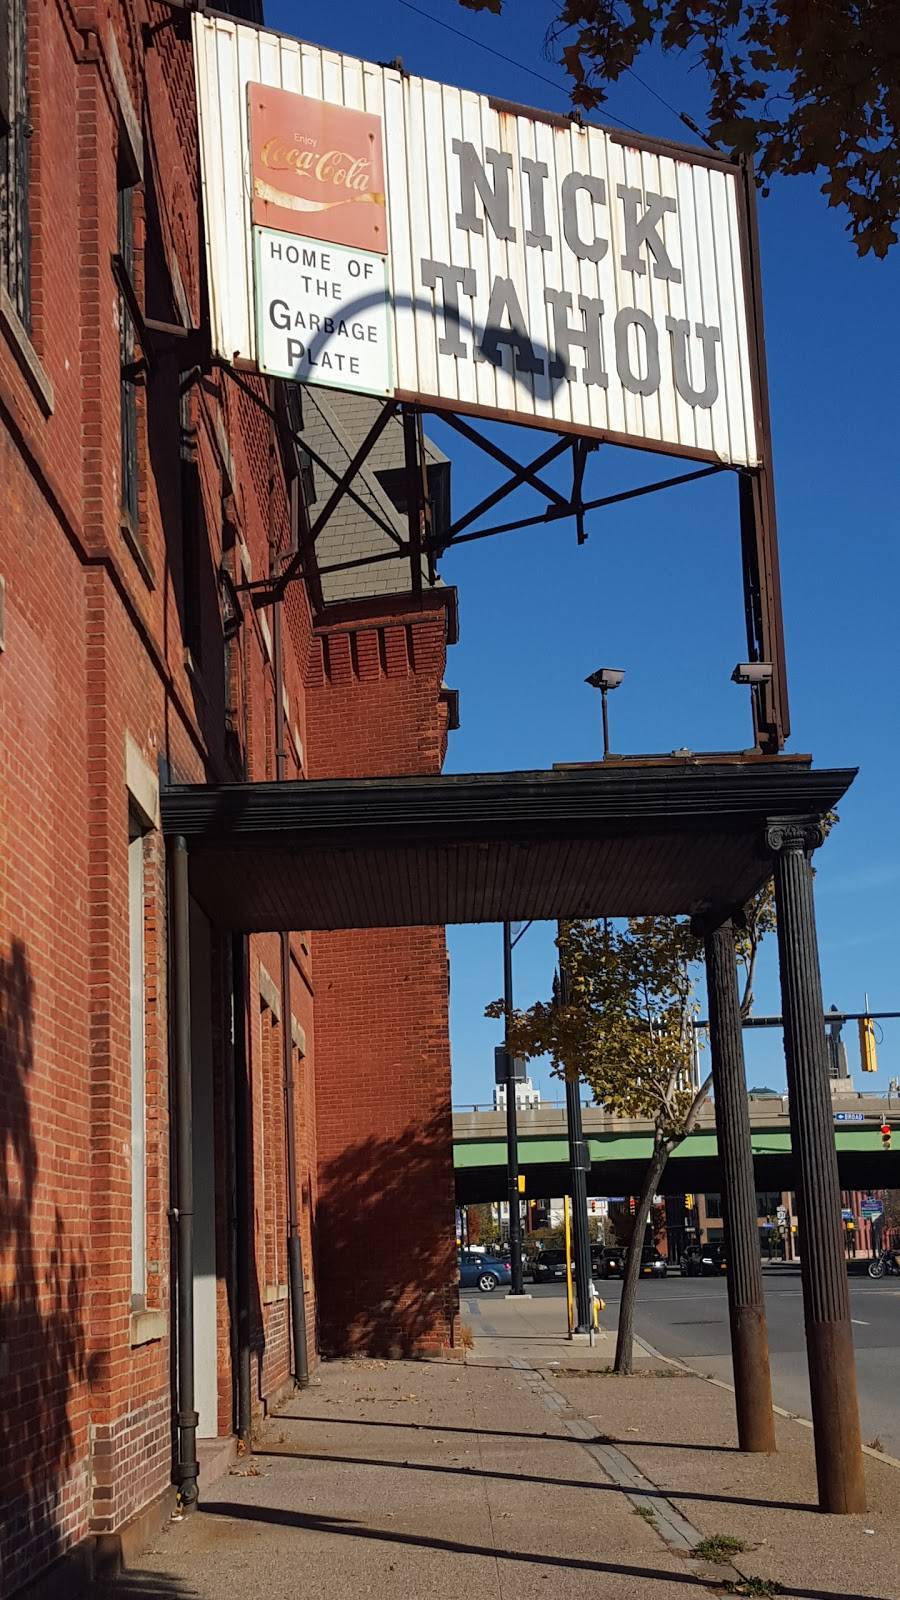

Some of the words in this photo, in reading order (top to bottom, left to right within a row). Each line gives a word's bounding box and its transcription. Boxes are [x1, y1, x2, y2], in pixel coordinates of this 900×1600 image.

[294, 133, 318, 147] Enjoy
[452, 138, 682, 284] NICK
[270, 241, 331, 271] HOME
[347, 259, 374, 280] OF
[301, 275, 342, 300] THE
[269, 299, 378, 343] GARBAGE
[421, 258, 721, 410] TAHOU
[287, 337, 360, 374] PLATE
